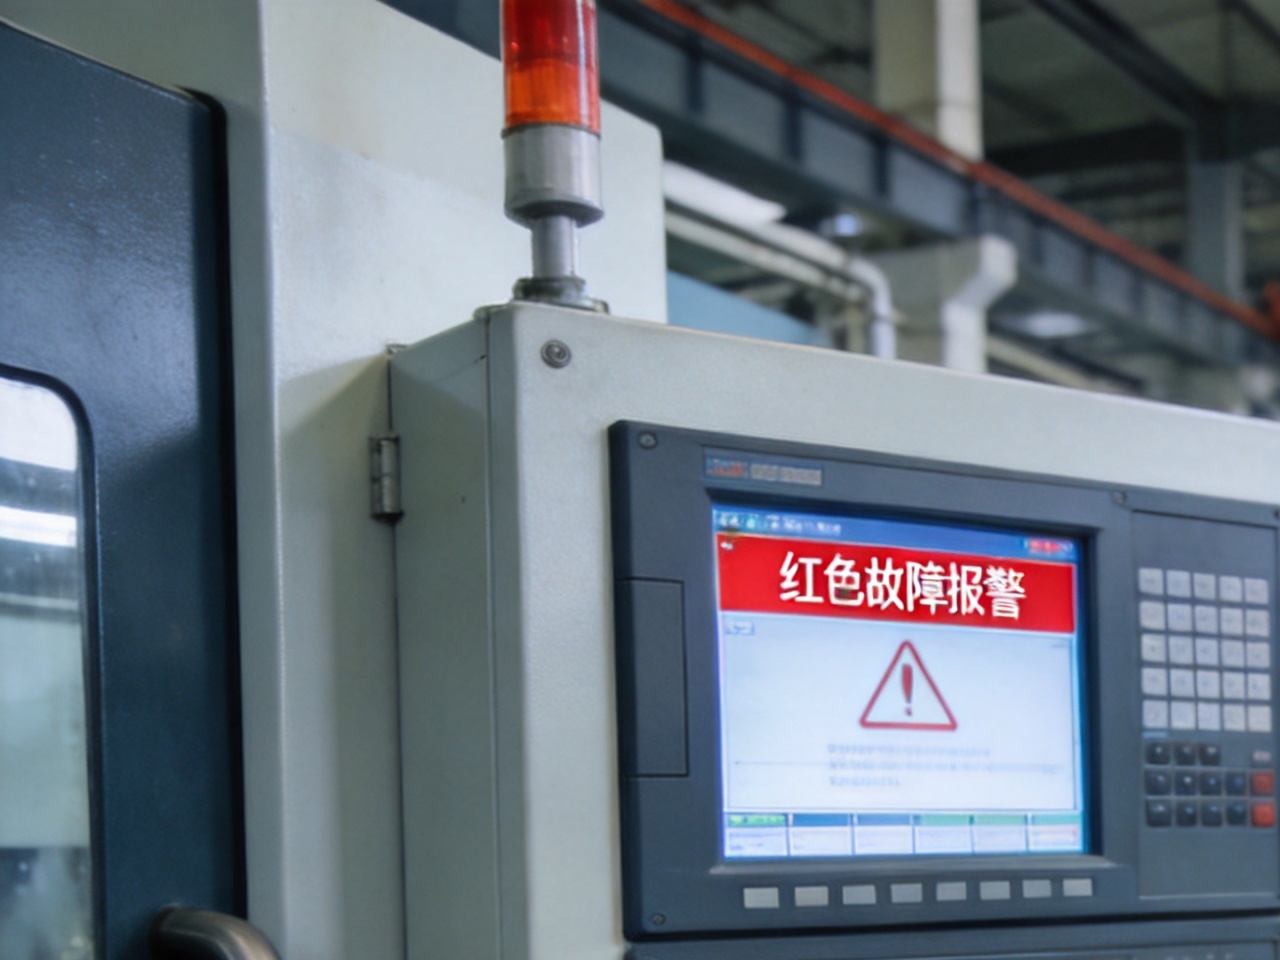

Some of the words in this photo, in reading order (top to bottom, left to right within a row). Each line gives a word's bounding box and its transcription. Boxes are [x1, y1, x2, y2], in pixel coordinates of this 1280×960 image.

[779, 551, 1026, 620] 红色故障报警
